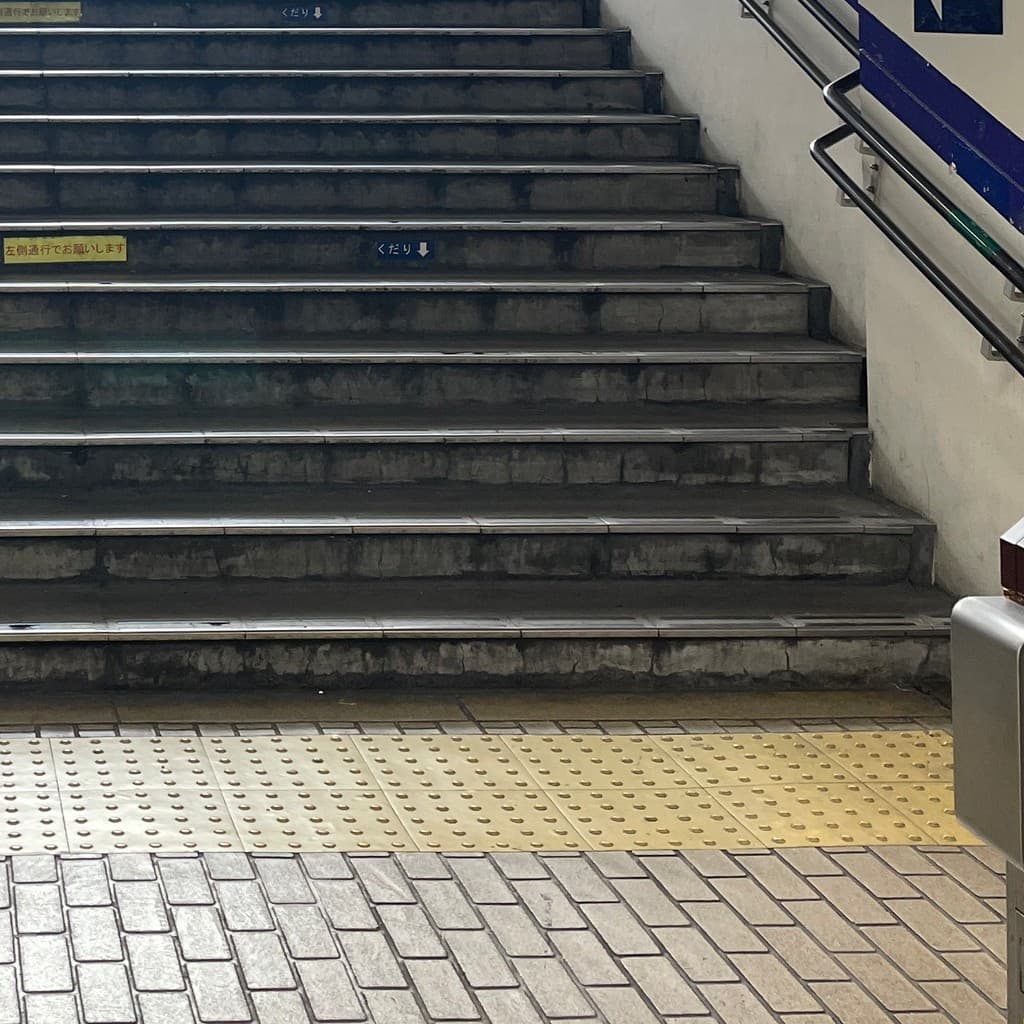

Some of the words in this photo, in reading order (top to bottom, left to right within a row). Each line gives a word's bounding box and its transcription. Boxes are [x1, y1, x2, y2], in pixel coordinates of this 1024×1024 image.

[5, 243, 125, 257] 左側通行でお願いします
[378, 243, 411, 255] くだり
